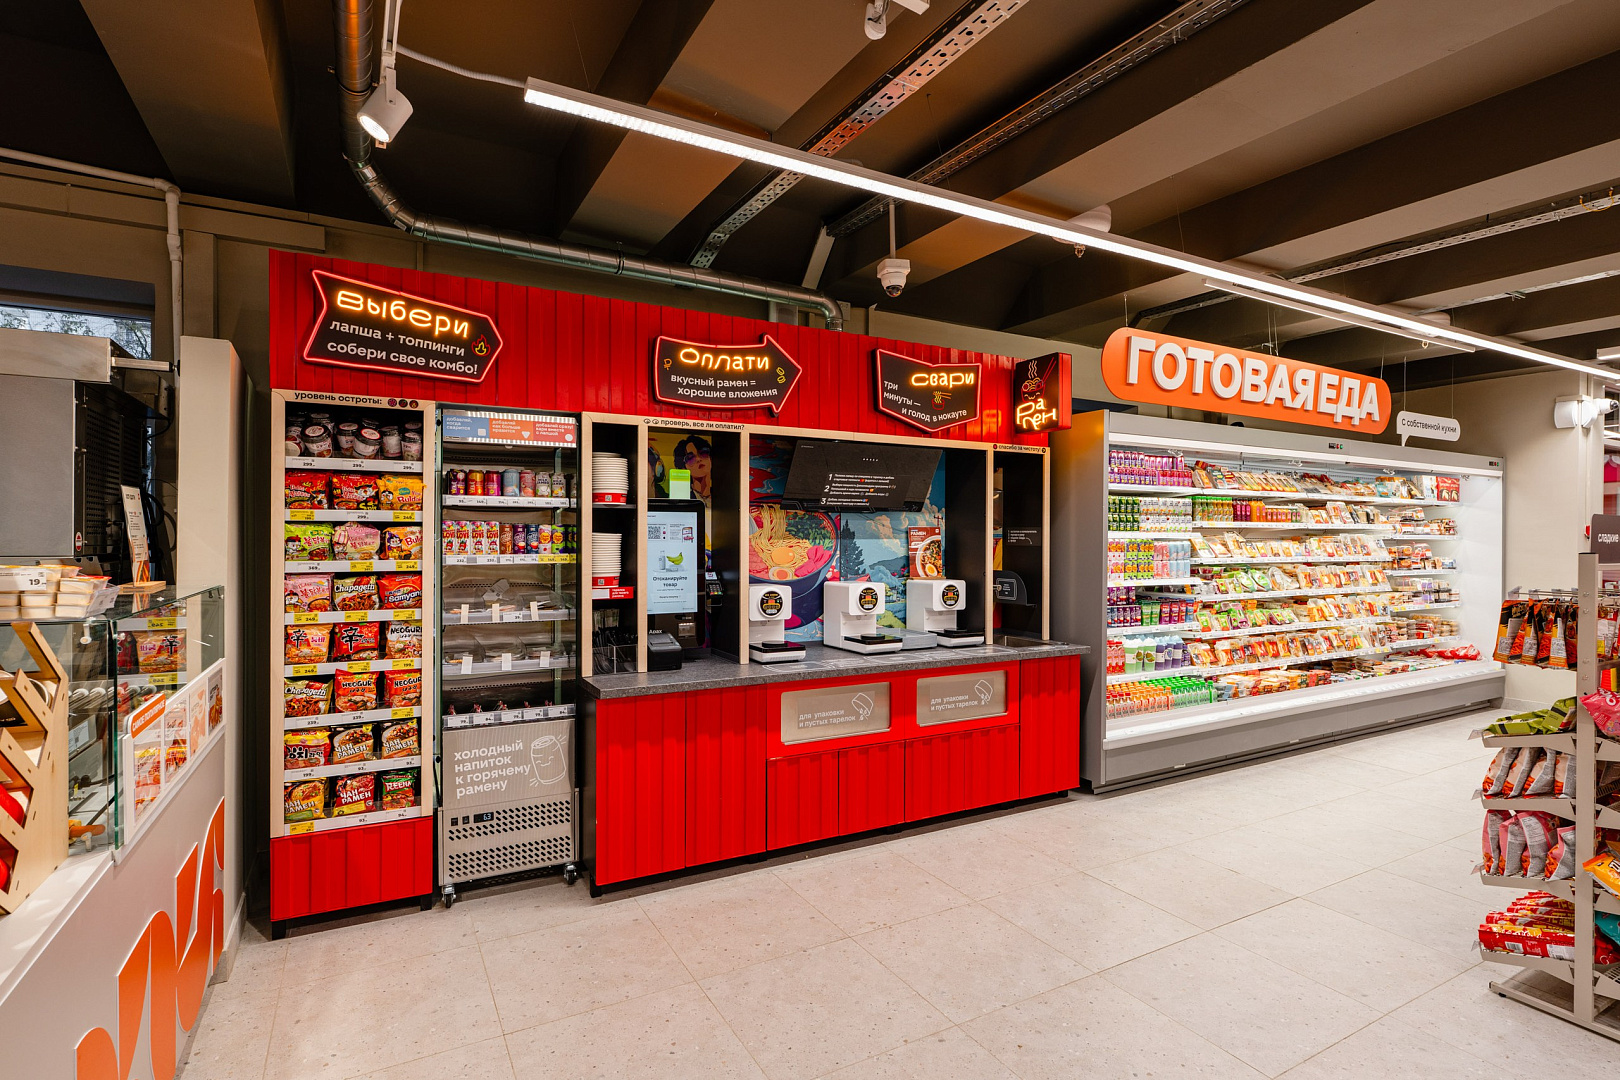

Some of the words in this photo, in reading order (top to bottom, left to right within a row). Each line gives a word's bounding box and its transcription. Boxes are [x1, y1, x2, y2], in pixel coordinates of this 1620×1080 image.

[336, 290, 470, 338] Выбери
[329, 320, 382, 340] лапша
[398, 333, 466, 357] топпинги
[327, 341, 386, 361] собери
[389, 352, 426, 367] свое
[429, 359, 478, 375] комбо!
[679, 348, 769, 370] Оплати
[670, 374, 715, 387] вкусный
[717, 379, 748, 389] рамен
[883, 380, 898, 391] три
[295, 392, 336, 401] уровень
[338, 395, 382, 405] остроты:
[677, 387, 726, 399] хорошие
[728, 388, 778, 399] вложения
[883, 391, 913, 406] минуты
[908, 409, 931, 422] голод
[938, 409, 967, 421] нокауте
[660, 420, 692, 428] проверь,
[1401, 418, 1406, 426] С
[1406, 420, 1440, 431] собственной
[1441, 425, 1457, 434] кухни
[936, 702, 957, 711] пустых
[957, 700, 979, 708] тарелок
[943, 694, 969, 703] упаковки
[799, 713, 812, 721] для
[813, 709, 845, 719] упаковки
[804, 718, 829, 728] пустых
[829, 715, 856, 724] тарелок
[337, 745, 368, 759] РАМЕН
[385, 740, 414, 754] РАМЕН
[454, 740, 524, 761] холодный
[455, 755, 512, 773] напиток
[455, 776, 463, 785] к
[467, 764, 531, 783] горячему
[340, 789, 358, 798] ЧАН
[456, 780, 508, 800] рамену
[341, 791, 371, 804] РАМЕН
